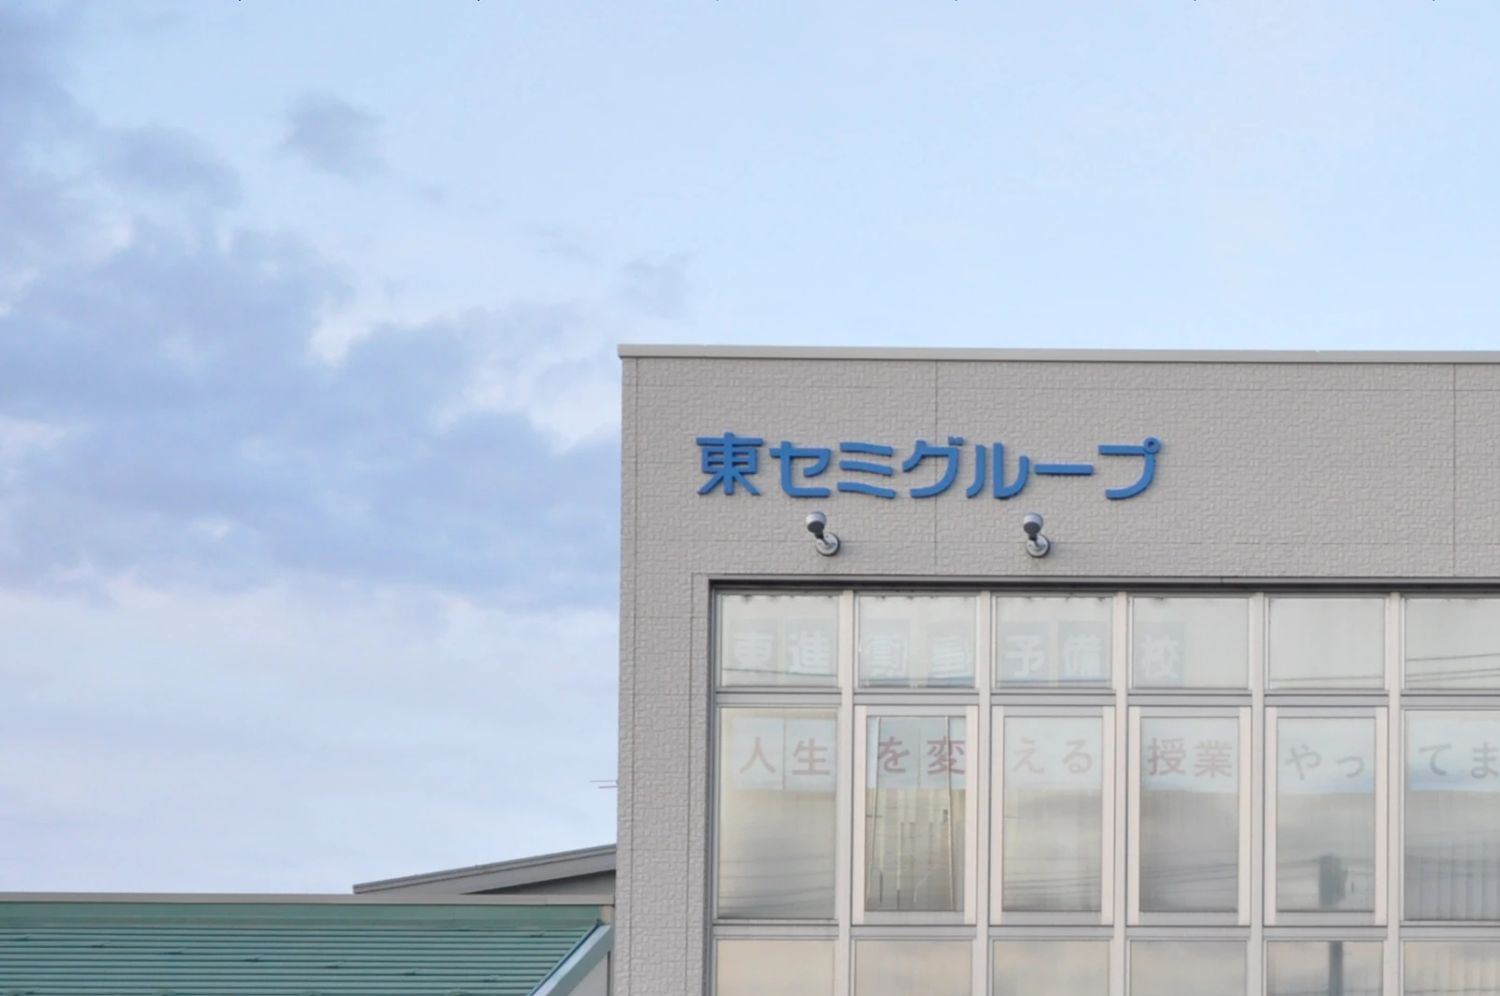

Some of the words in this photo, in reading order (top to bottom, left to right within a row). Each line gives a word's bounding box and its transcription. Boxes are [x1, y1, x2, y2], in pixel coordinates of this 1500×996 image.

[695, 431, 1161, 500] 東セミグループ
